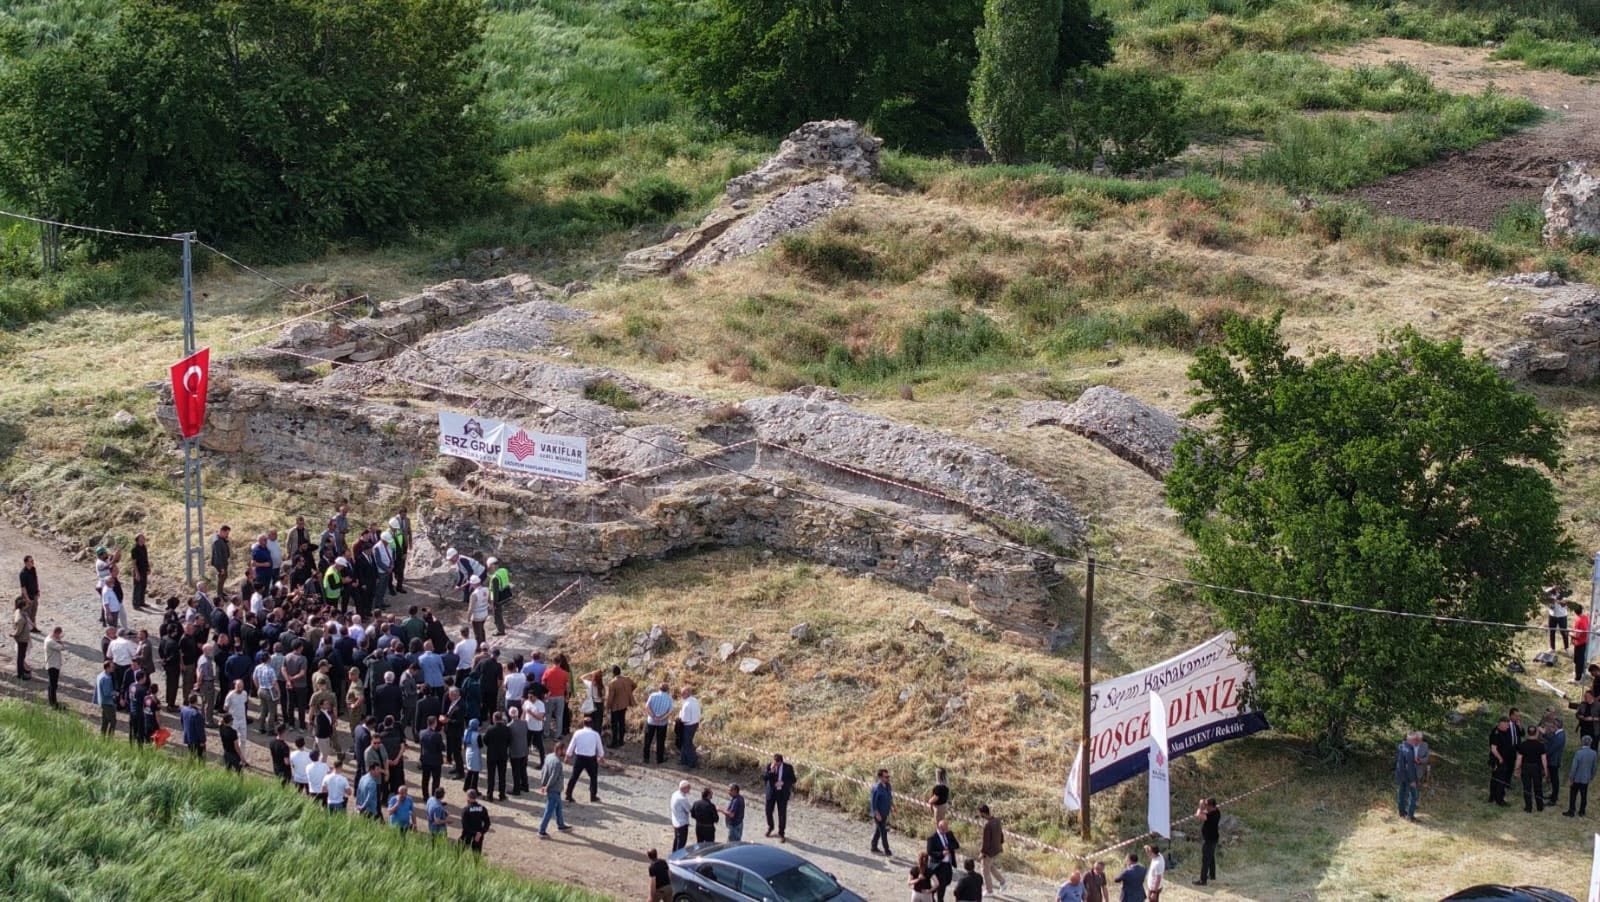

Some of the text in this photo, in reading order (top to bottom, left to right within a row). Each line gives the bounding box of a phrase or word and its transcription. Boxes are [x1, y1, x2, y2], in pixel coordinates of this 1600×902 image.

[445, 435, 502, 455] ERZ GRUP
[540, 443, 583, 458] VAKIFLAR
[1103, 686, 1139, 711] Sayın
[1090, 675, 1239, 764] HOŞGEDİNİZ
